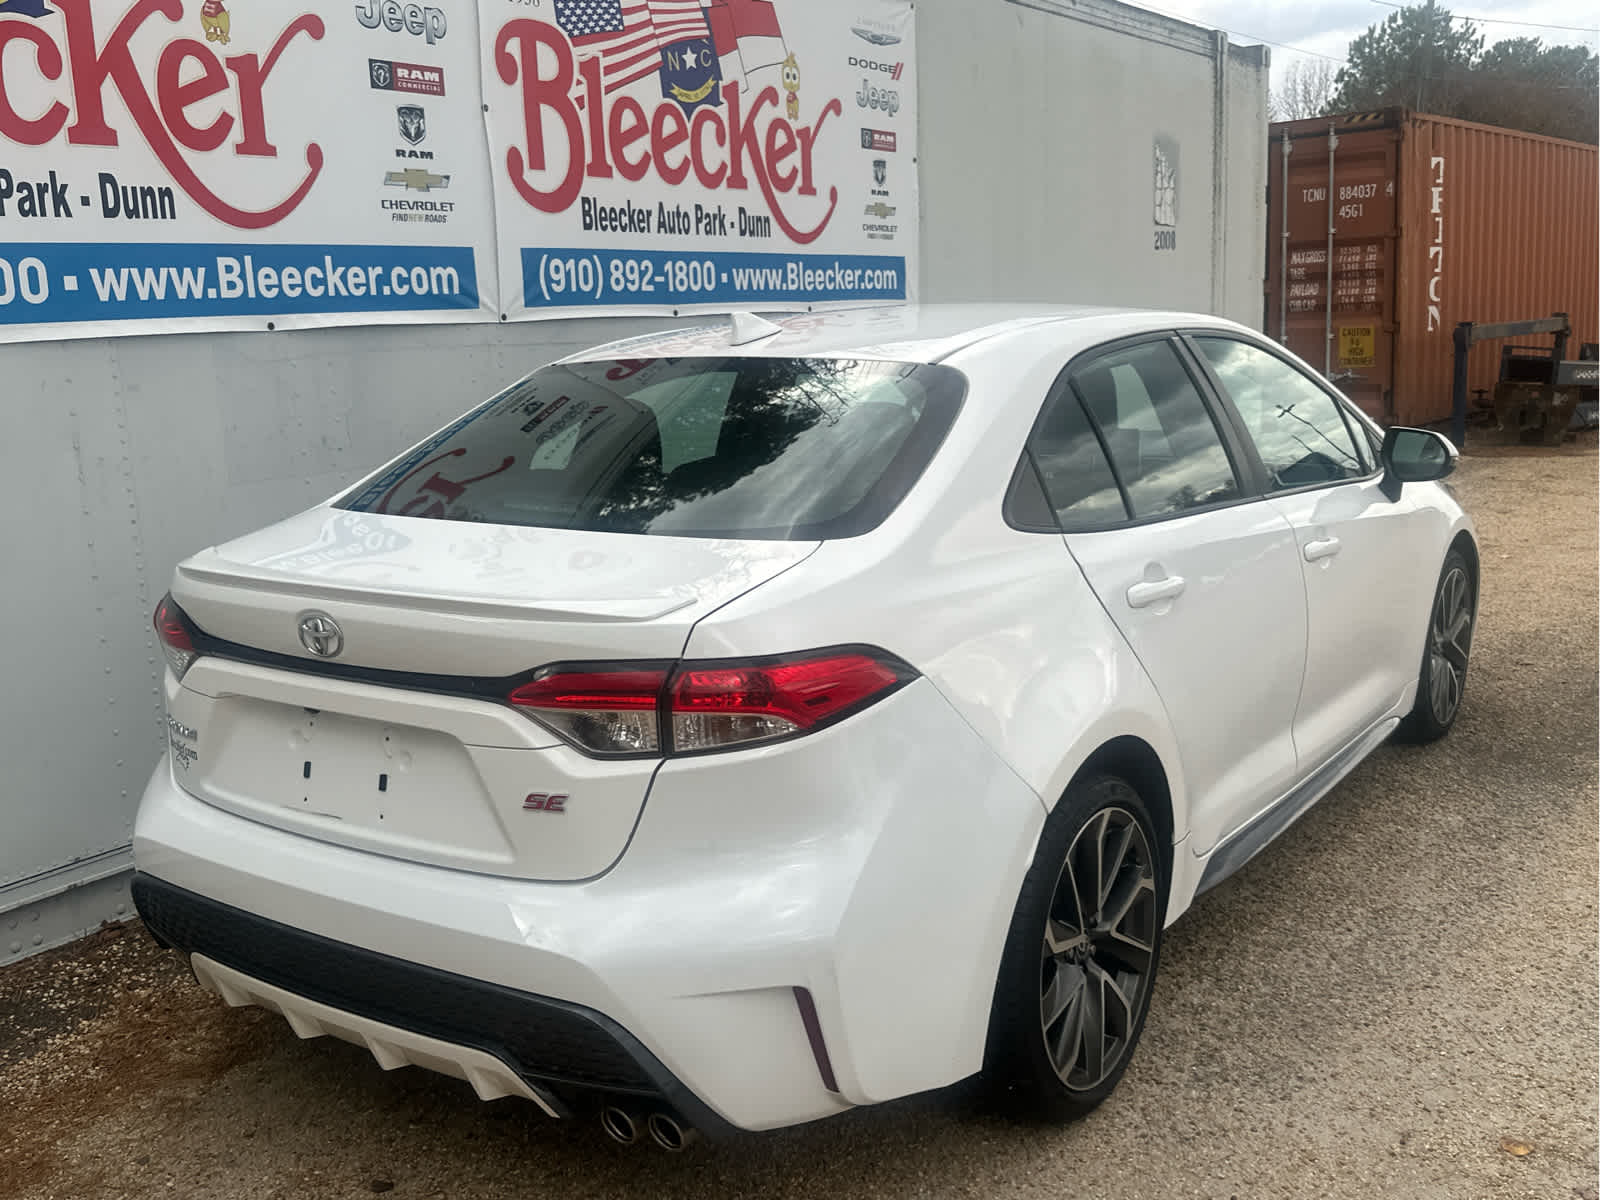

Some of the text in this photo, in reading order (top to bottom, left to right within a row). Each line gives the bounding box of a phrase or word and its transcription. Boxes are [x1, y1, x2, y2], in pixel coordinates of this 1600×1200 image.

[355, 0, 447, 45] Jeep
[396, 68, 440, 82] RAM
[848, 57, 897, 74] DODGE
[856, 79, 900, 117] Jeep
[495, 19, 842, 245] Bleecker
[395, 149, 434, 160] RAM
[0, 168, 177, 220] Park Dunn
[871, 189, 889, 197] RAM
[1303, 187, 1327, 203] TCNU
[1339, 184, 1377, 200] 884037
[381, 200, 455, 212] CHEVROLET
[581, 196, 771, 238] Bleecker Auto Park Dunn
[1154, 231, 1176, 250] 2008
[89, 255, 460, 302] www.Bleecker.com
[539, 254, 897, 300] (910) 892-1800 www.Bleecker.com
[522, 792, 570, 813] SE
